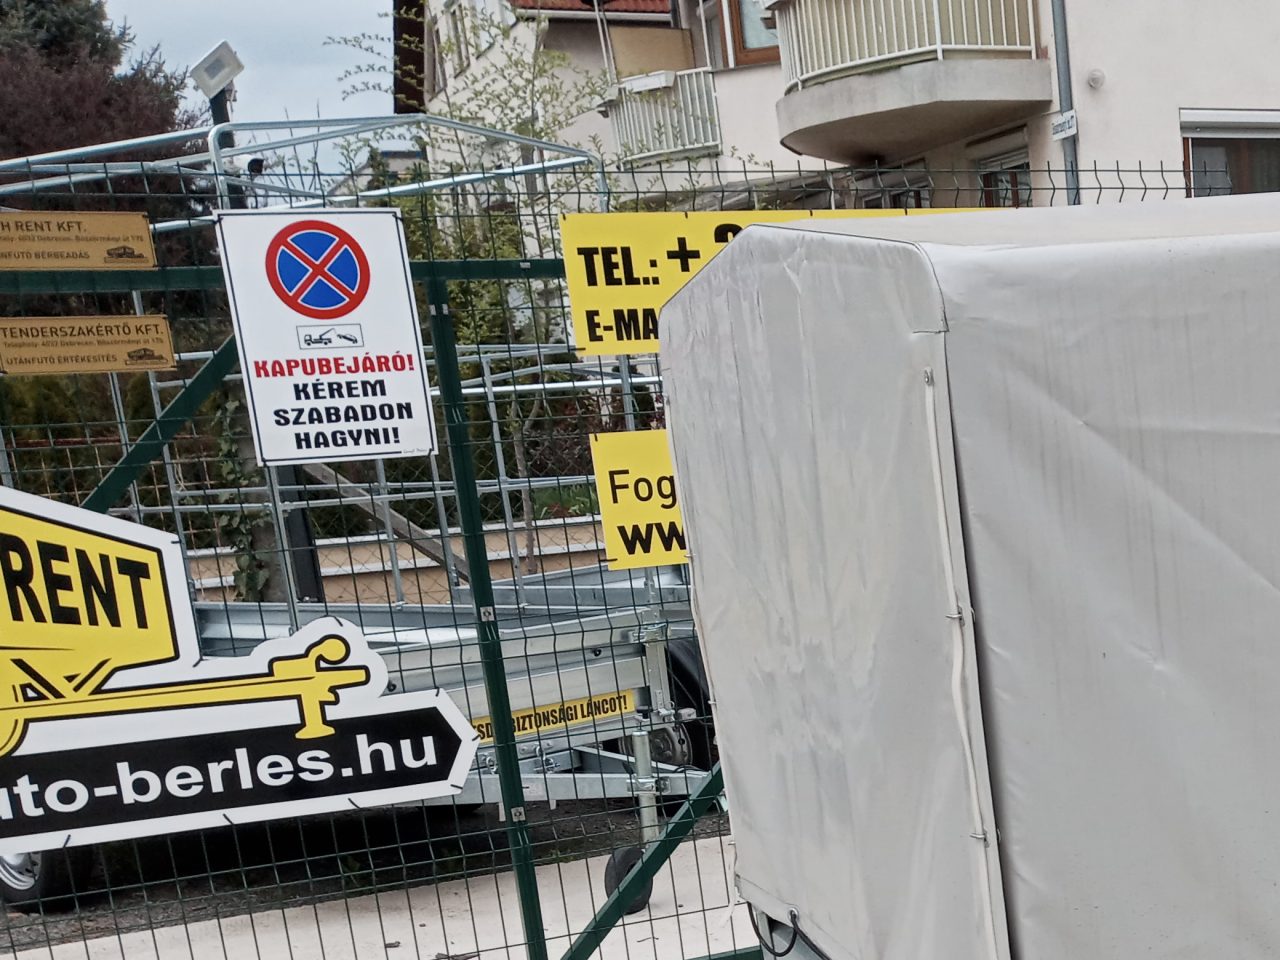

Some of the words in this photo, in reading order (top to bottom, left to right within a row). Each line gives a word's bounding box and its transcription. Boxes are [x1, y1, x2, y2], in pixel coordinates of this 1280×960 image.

[15, 220, 51, 232] RENT
[57, 220, 87, 233] KFT.
[576, 246, 660, 287] TEL.:
[135, 323, 165, 336] KFT.
[253, 350, 415, 378] KAPUBEJÁRÓ!
[293, 378, 387, 401] KÉREM
[273, 402, 414, 427] SZABADON
[294, 427, 401, 450] HAGYNI!
[0, 531, 151, 629] RENT
